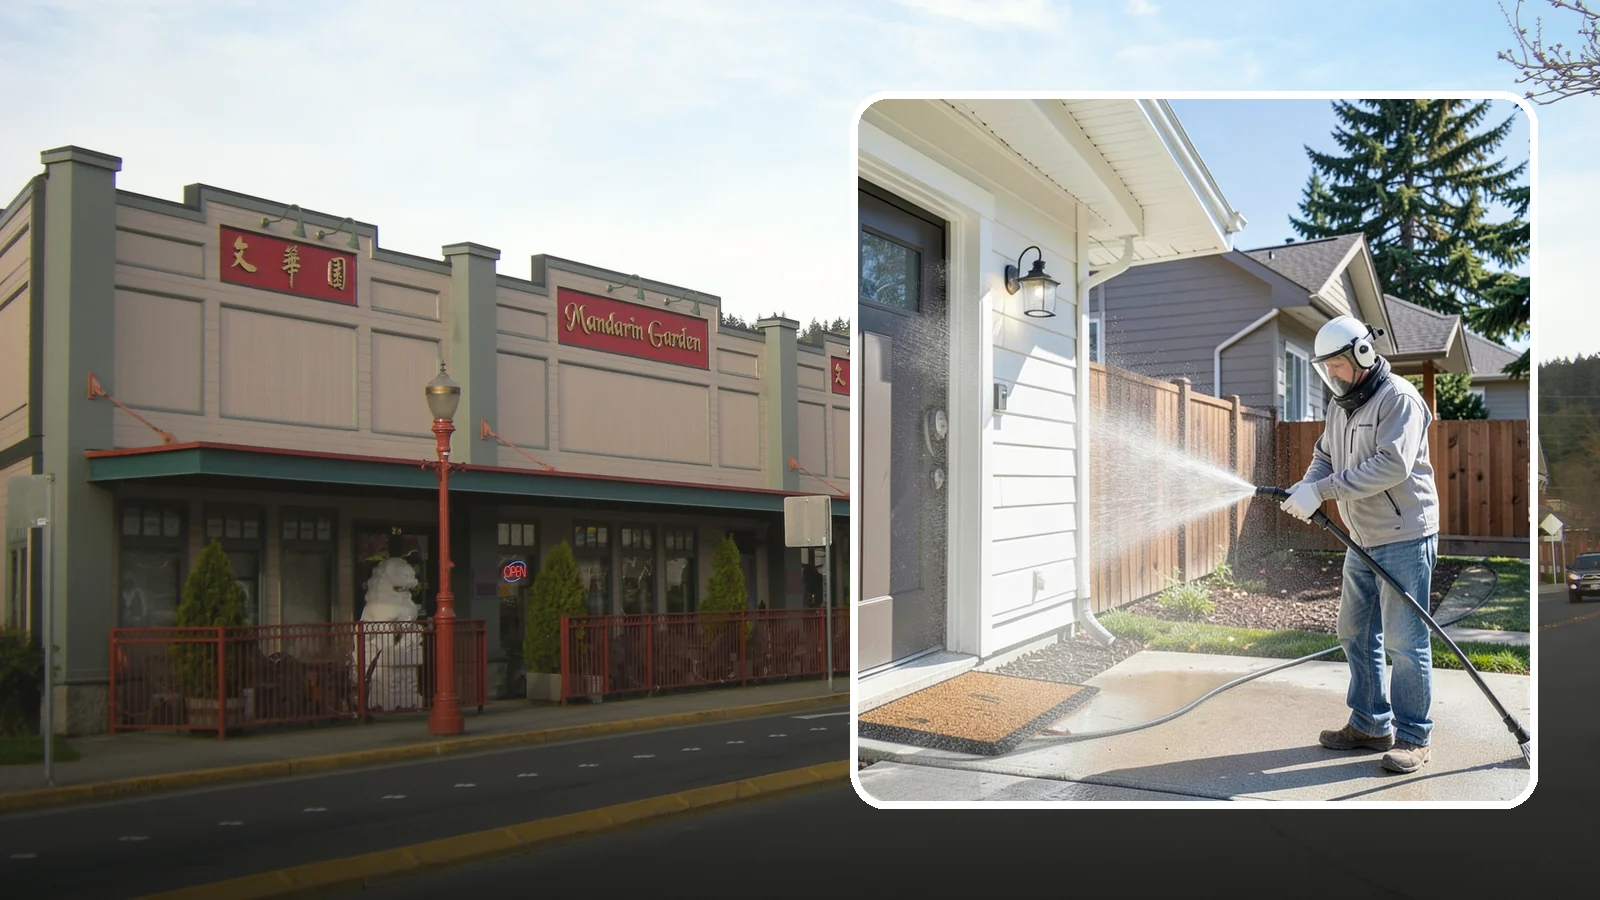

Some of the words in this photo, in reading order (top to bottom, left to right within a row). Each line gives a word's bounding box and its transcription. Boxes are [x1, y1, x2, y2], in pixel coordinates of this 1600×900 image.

[231, 236, 346, 291] 文華園
[564, 302, 644, 341] Mandarin
[648, 320, 702, 352] Garden
[835, 363, 846, 386] 文
[503, 565, 527, 578] OPEN
